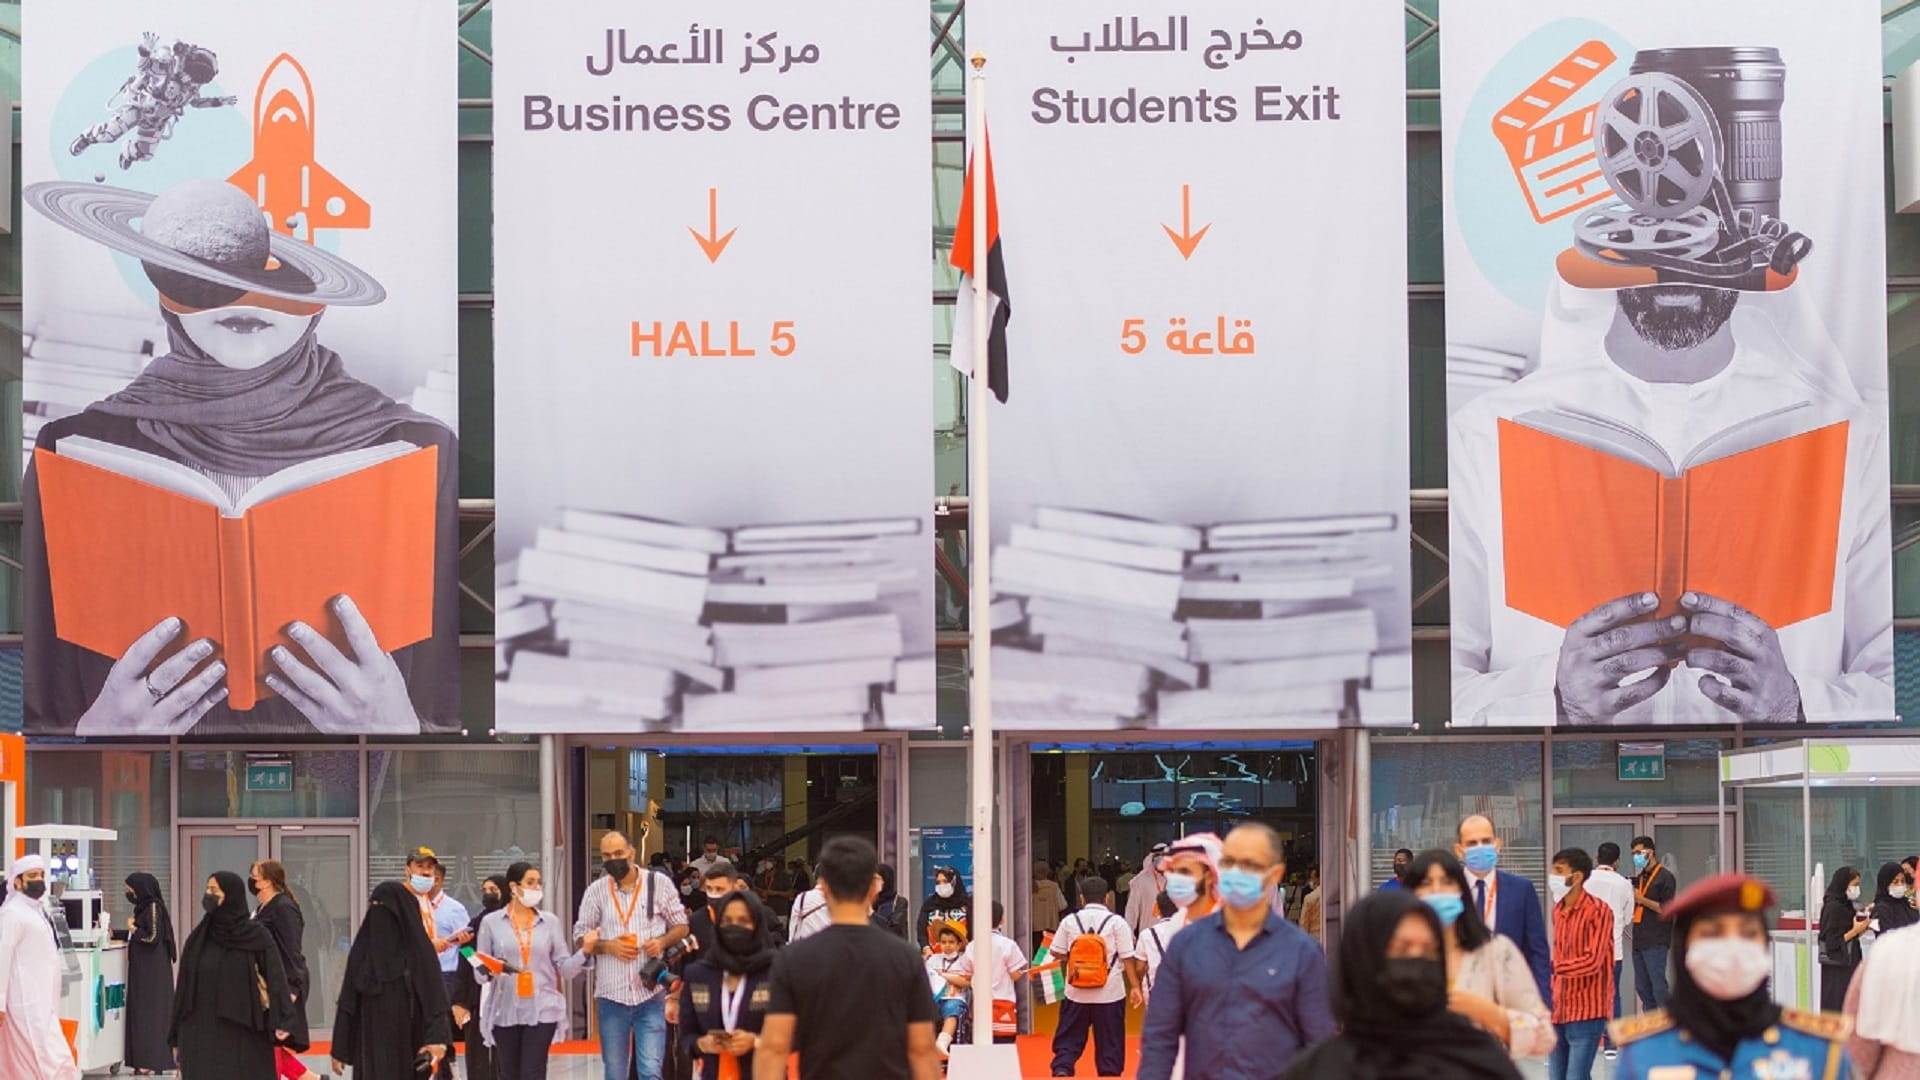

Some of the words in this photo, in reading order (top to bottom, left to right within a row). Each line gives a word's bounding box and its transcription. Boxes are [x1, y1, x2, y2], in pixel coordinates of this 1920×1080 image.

[586, 23, 723, 76] الأعمال
[739, 31, 821, 74] مركز
[1050, 16, 1188, 64] الطلاب
[1203, 18, 1303, 70] مخرج
[523, 95, 732, 132] Business
[746, 94, 901, 131] Centre
[1031, 87, 1238, 124] Students
[1254, 85, 1341, 121] Exit
[630, 321, 756, 357] HALL
[770, 321, 797, 357] 5
[1120, 319, 1147, 355] 5
[1165, 316, 1256, 355] قاعة
